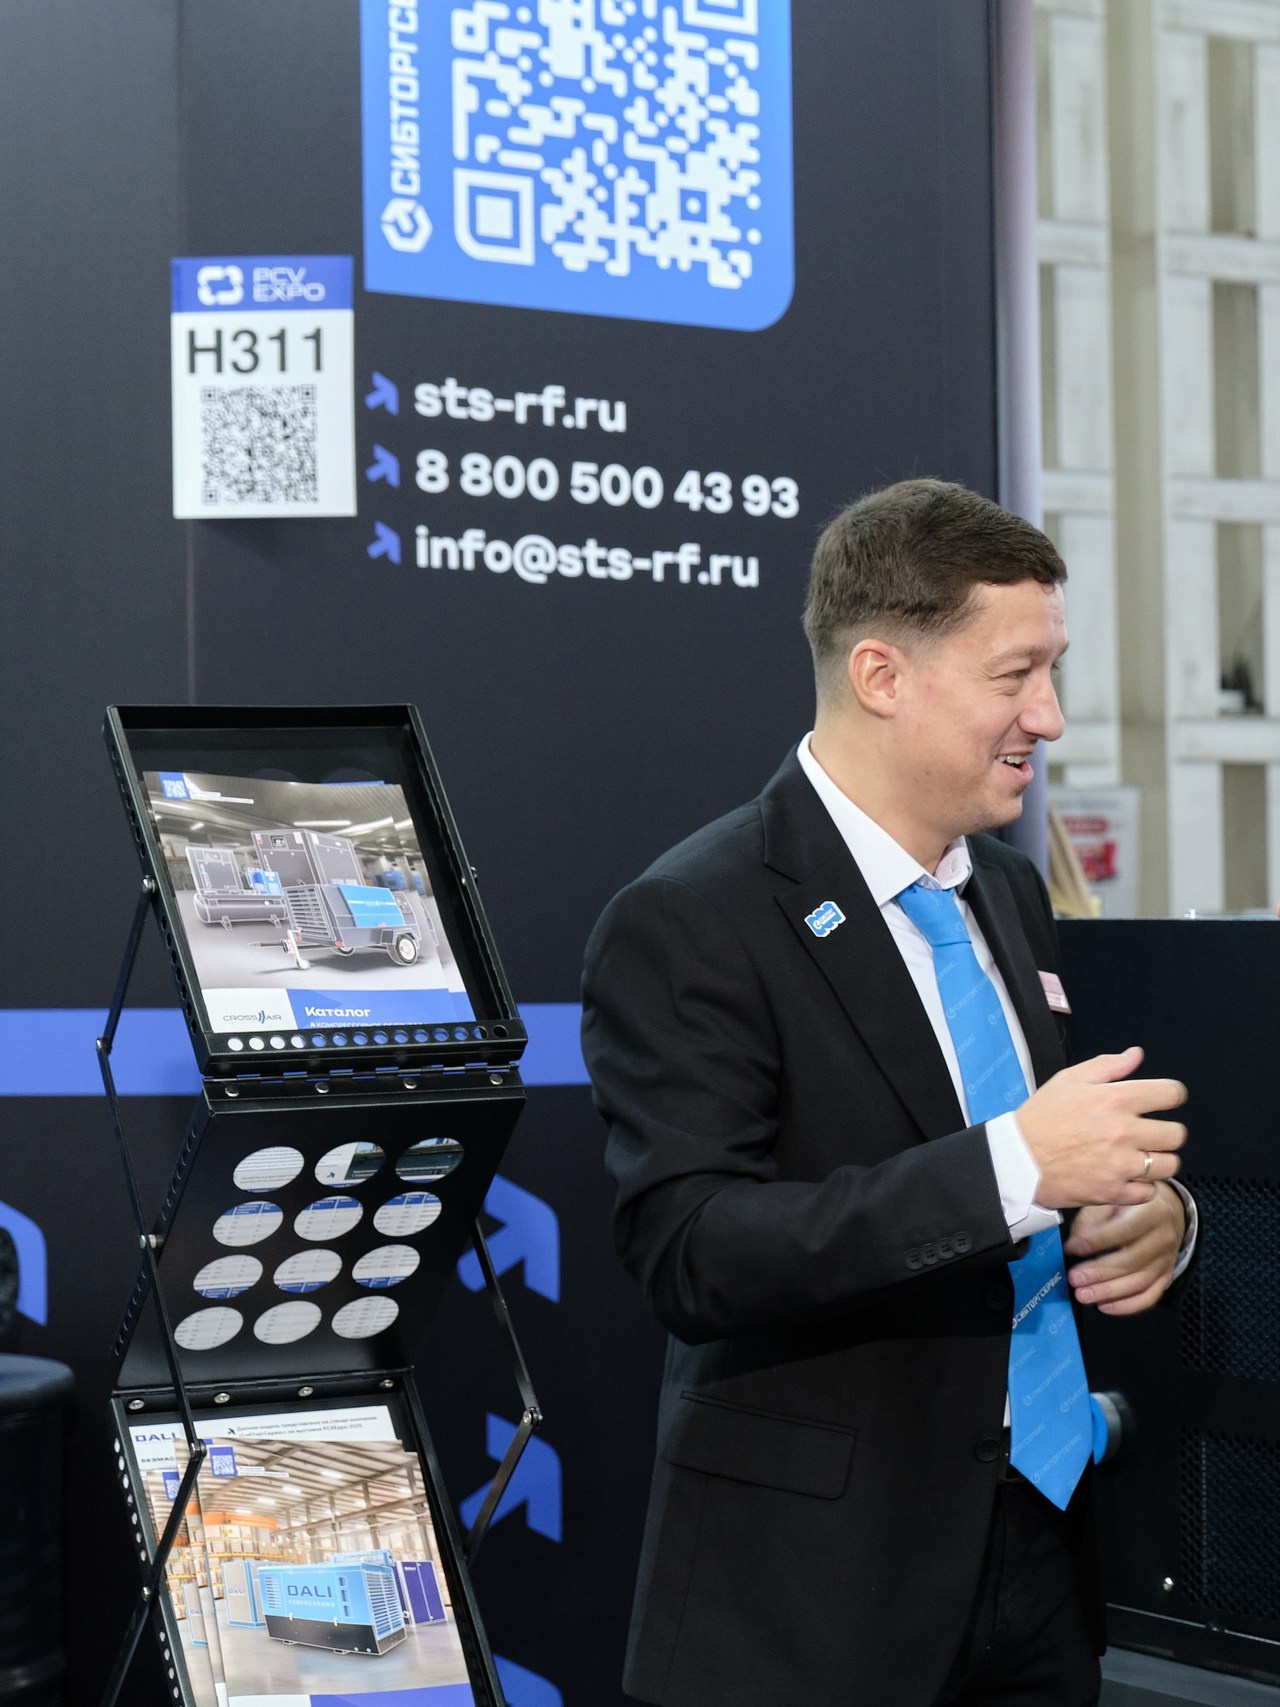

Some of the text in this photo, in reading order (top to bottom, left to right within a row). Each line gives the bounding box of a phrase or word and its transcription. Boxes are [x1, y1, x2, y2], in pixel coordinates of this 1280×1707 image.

[252, 267, 306, 284] PCV
[252, 282, 326, 303] EXPO
[188, 327, 322, 374] H311
[414, 377, 627, 432] sts-rf.ru
[415, 449, 800, 519] 8 800 500 43 93
[415, 524, 760, 588] info@sts-rf.ru
[223, 1014, 258, 1022] CROSS
[304, 1006, 371, 1018] Каталог
[287, 1584, 332, 1598] DALI
